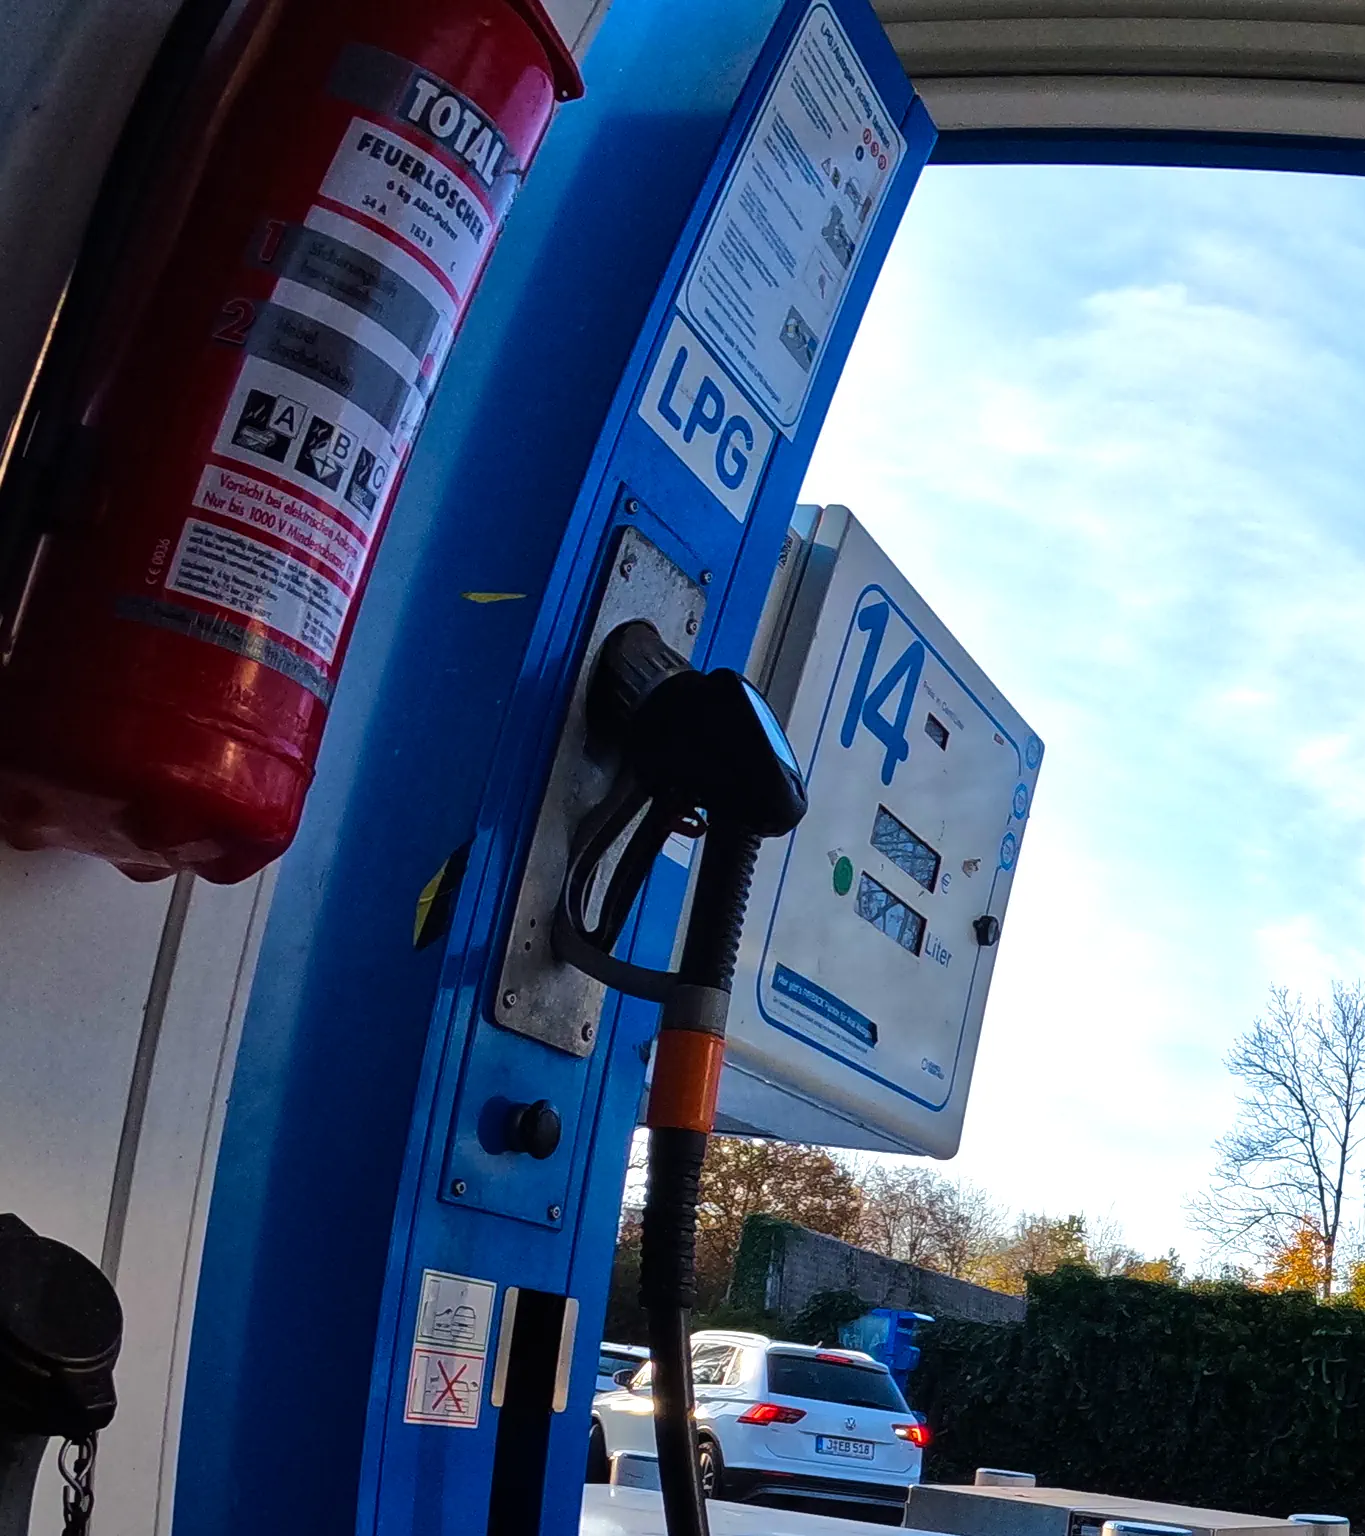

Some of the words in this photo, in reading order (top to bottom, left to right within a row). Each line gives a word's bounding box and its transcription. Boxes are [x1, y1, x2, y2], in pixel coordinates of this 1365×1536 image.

[407, 78, 504, 187] TOTAL
[356, 132, 485, 244] FEUERLÖSCHER
[212, 298, 256, 346] 2
[274, 406, 295, 430] A
[655, 345, 755, 492] LPG
[333, 433, 351, 459] B
[372, 466, 386, 490] C
[202, 491, 226, 509] Nur
[227, 497, 247, 516] bis
[247, 506, 278, 529] 1000
[278, 518, 290, 535] V
[218, 472, 264, 501] Vorsicht
[264, 491, 284, 508] bei
[282, 499, 335, 539] elektrischen
[839, 600, 926, 787] 14
[940, 872, 954, 896] €
[923, 929, 954, 969] Liter
[838, 1442, 850, 1452] EB
[853, 1444, 870, 1455] 518
